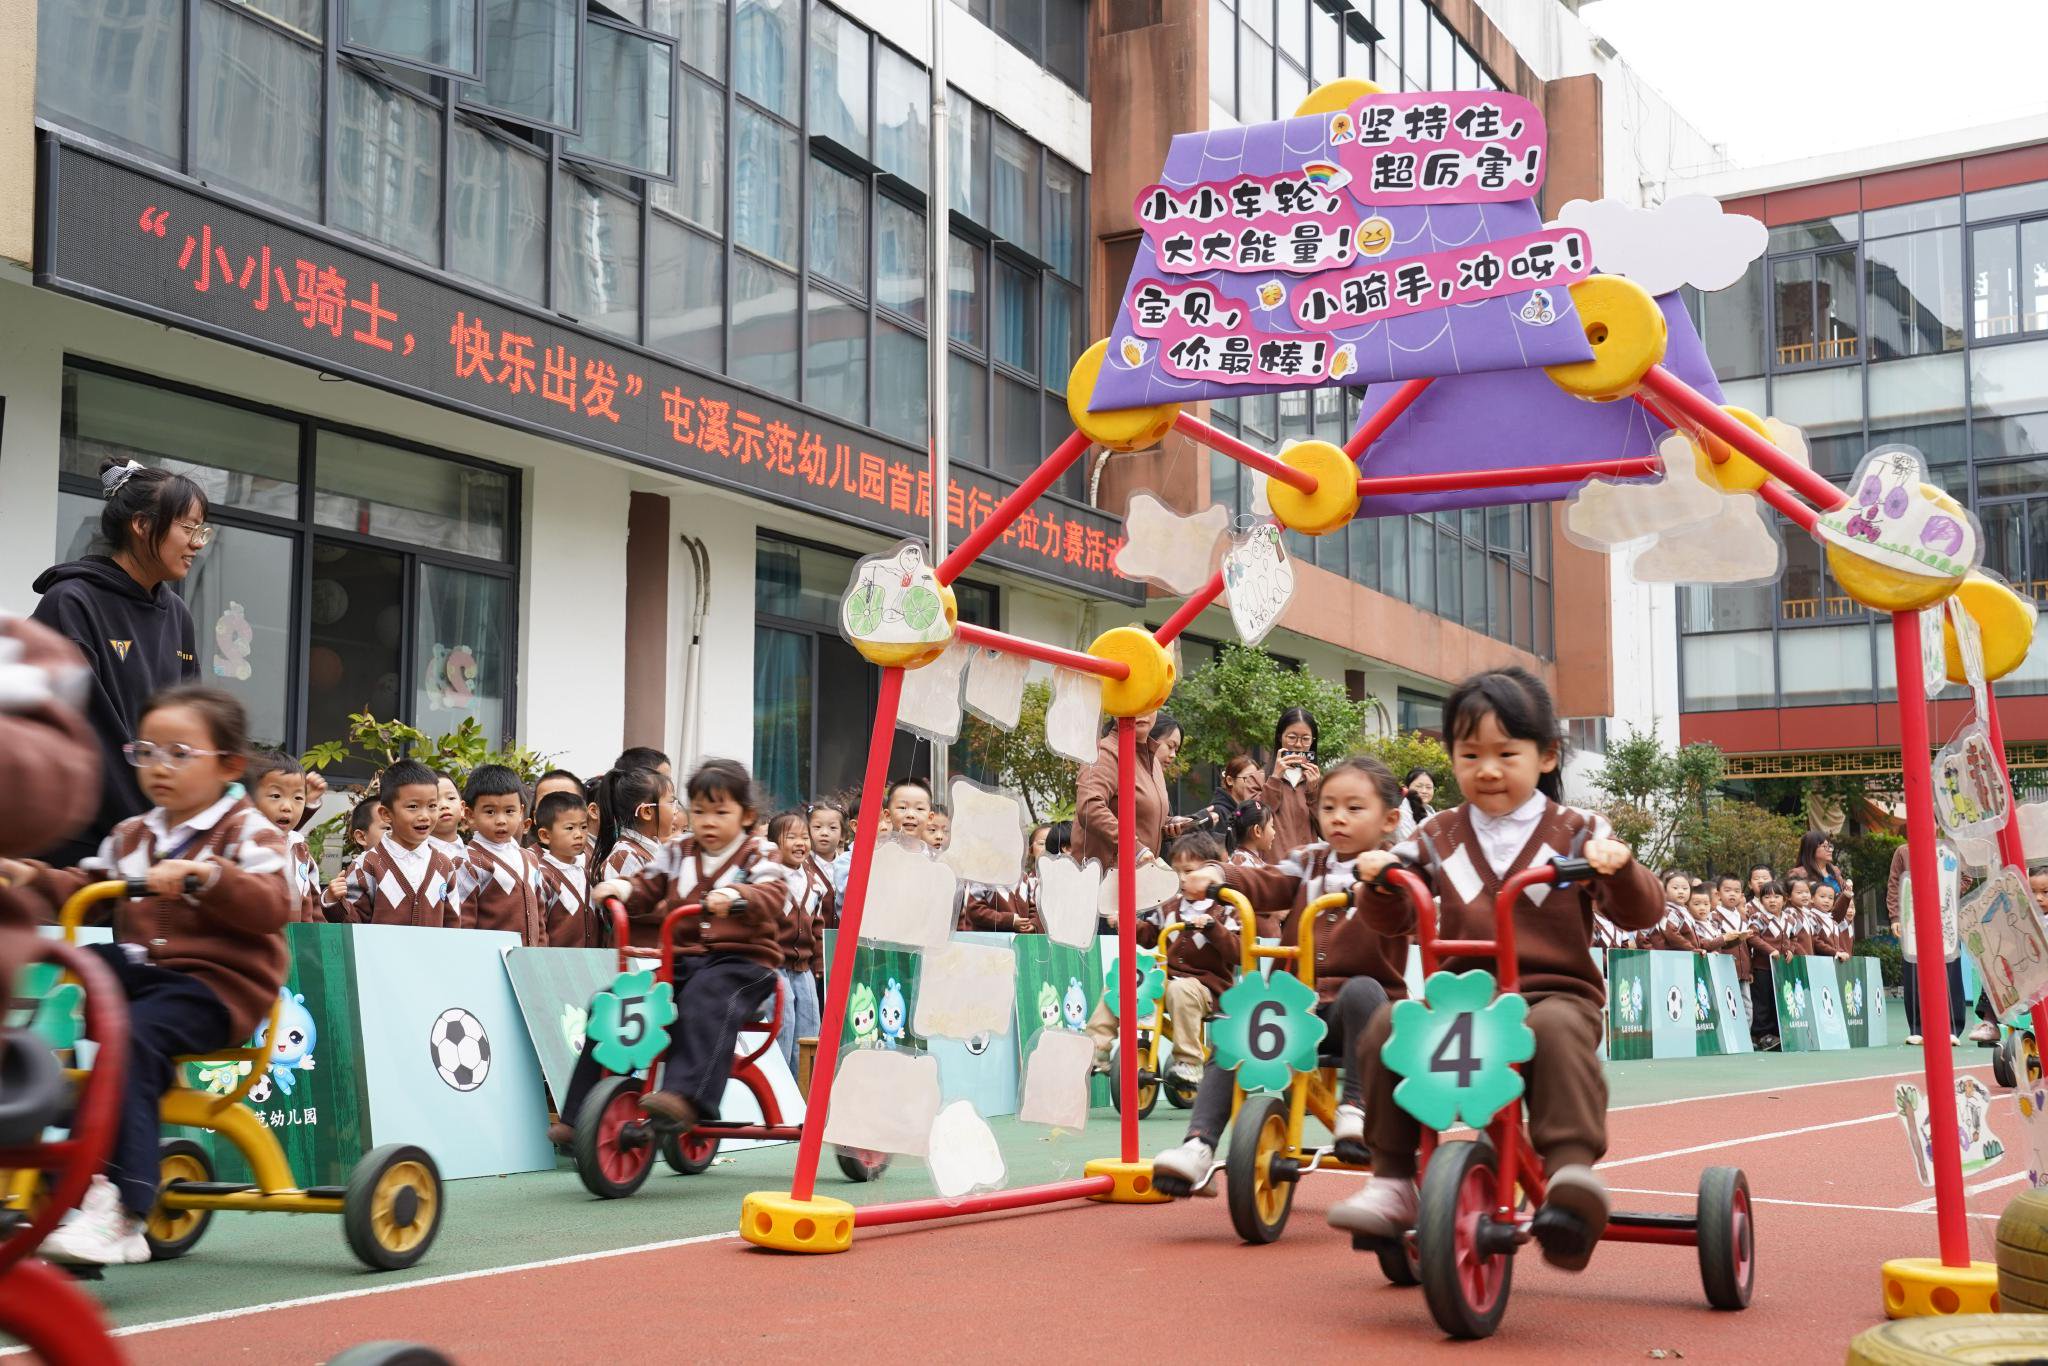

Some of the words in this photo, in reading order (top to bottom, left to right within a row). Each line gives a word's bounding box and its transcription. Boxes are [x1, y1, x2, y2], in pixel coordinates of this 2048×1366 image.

[1361, 105, 1522, 143] 坚持住，
[1374, 146, 1538, 190] 超厉害！
[1144, 181, 1339, 220] 小小车轮，
[1164, 225, 1350, 263] 大大能量！
[1137, 287, 1238, 325] 宝贝，
[1169, 336, 1325, 375] 你最棒！
[617, 995, 645, 1047] 5
[1248, 1000, 1286, 1060] 6
[1430, 1012, 1481, 1088] 4
